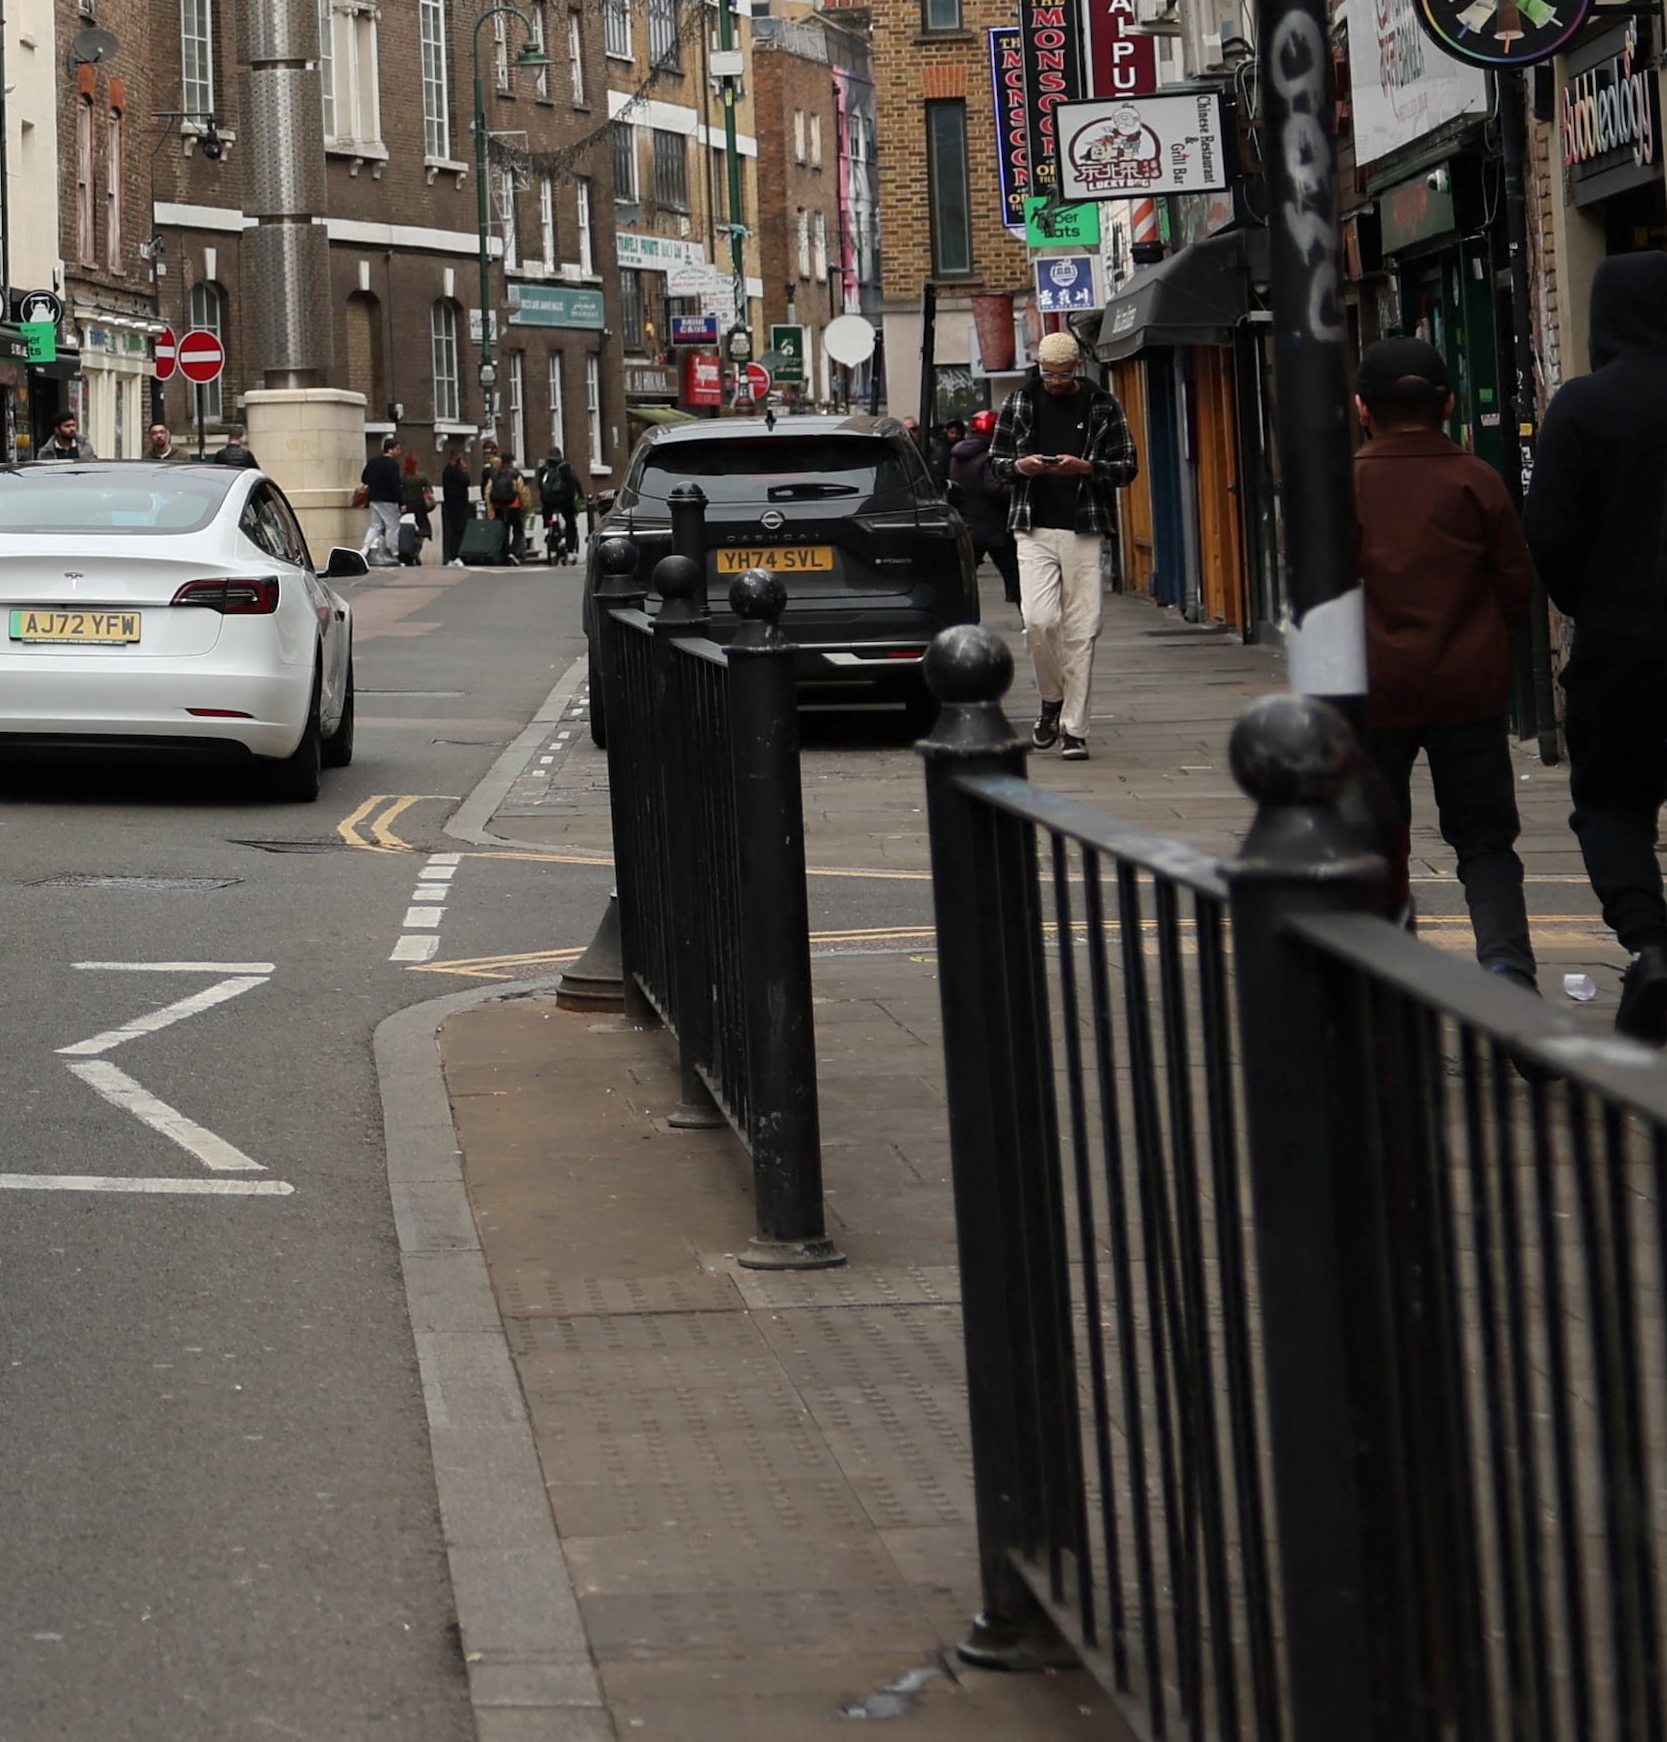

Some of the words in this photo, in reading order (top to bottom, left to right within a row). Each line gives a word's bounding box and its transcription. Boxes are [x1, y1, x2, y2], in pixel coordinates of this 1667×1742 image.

[1197, 95, 1212, 134] Chinese
[1562, 56, 1652, 167] Bubbleology
[1185, 136, 1199, 145] &
[1171, 143, 1185, 165] Grill
[1200, 135, 1216, 184] Restaurant
[1173, 168, 1187, 185] Bar
[724, 551, 777, 570] YH74
[784, 550, 823, 568] SVL
[25, 613, 84, 634] AJ72
[90, 615, 135, 635] YFW
